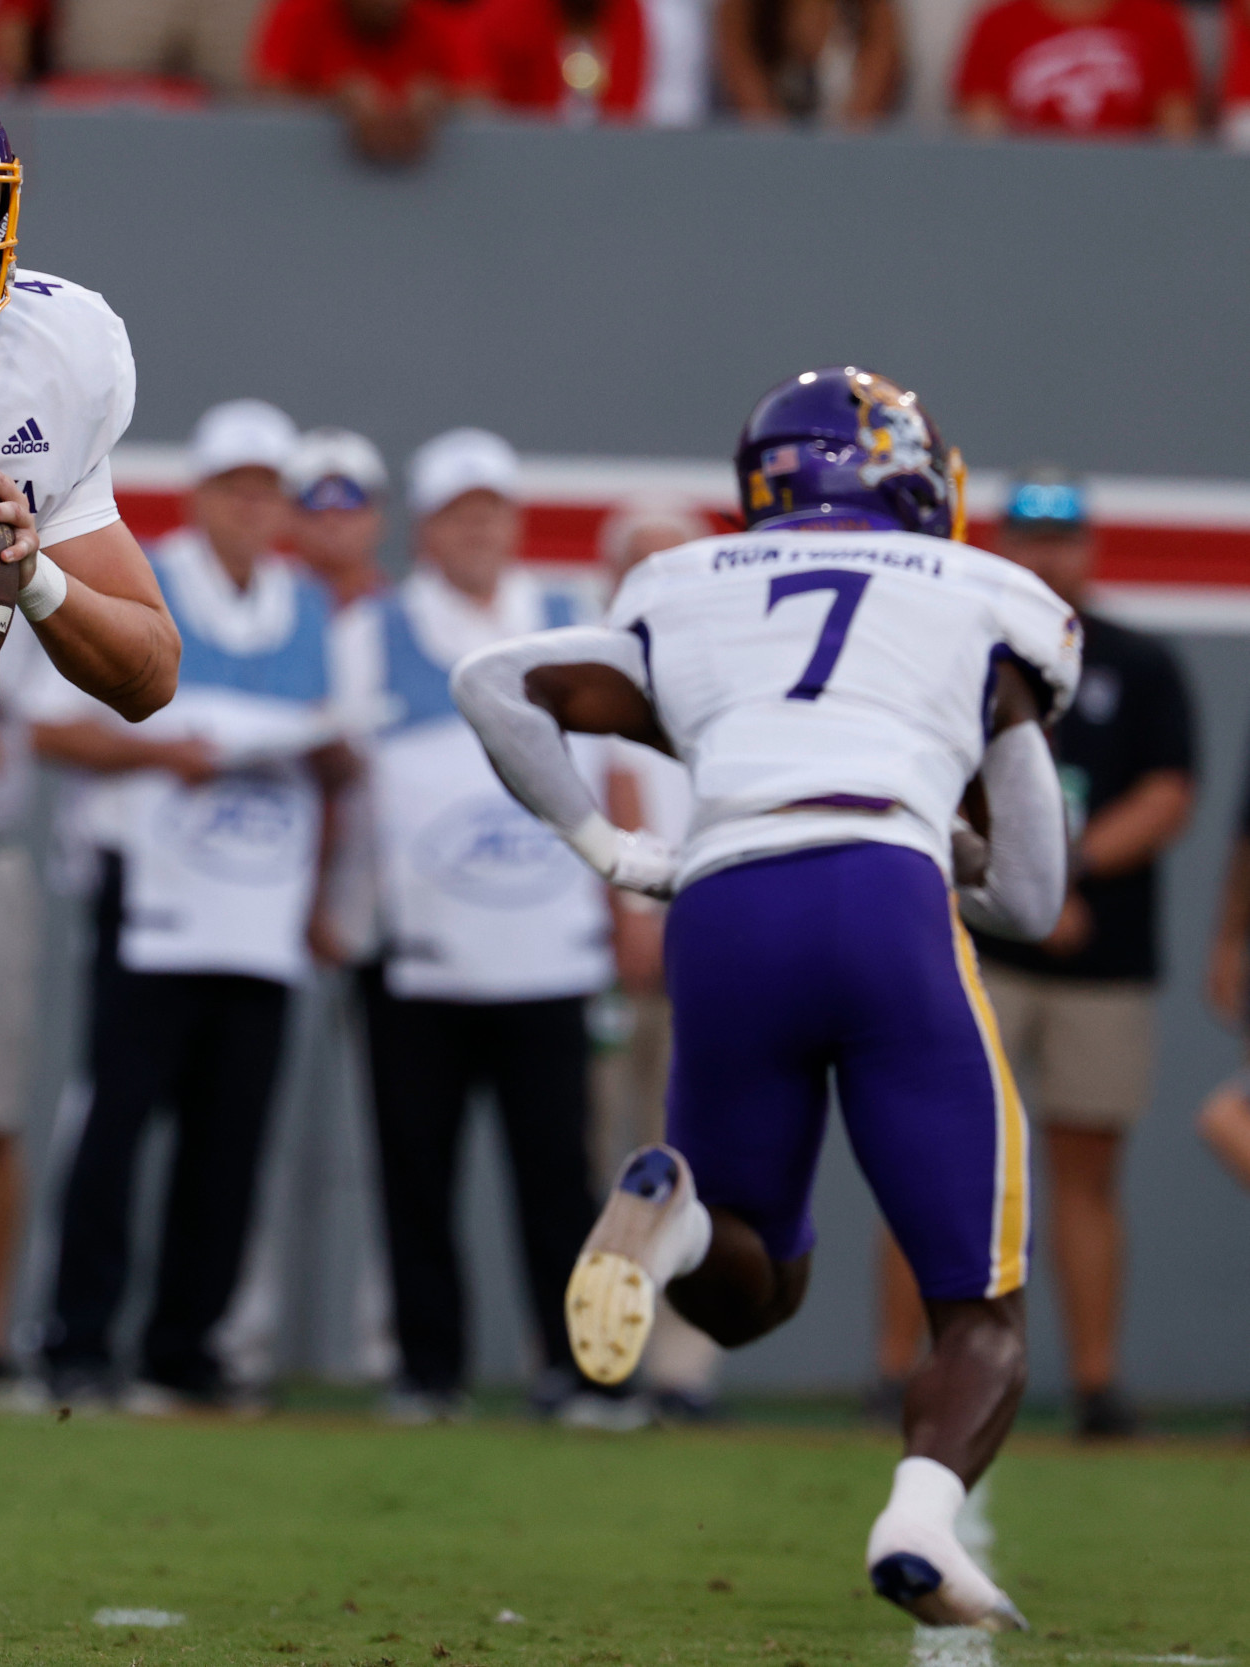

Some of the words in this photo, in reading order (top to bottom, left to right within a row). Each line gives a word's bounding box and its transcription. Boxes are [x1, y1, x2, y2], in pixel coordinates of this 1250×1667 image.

[14, 279, 64, 297] 4
[1, 440, 50, 456] adidas
[765, 569, 872, 701] 7
